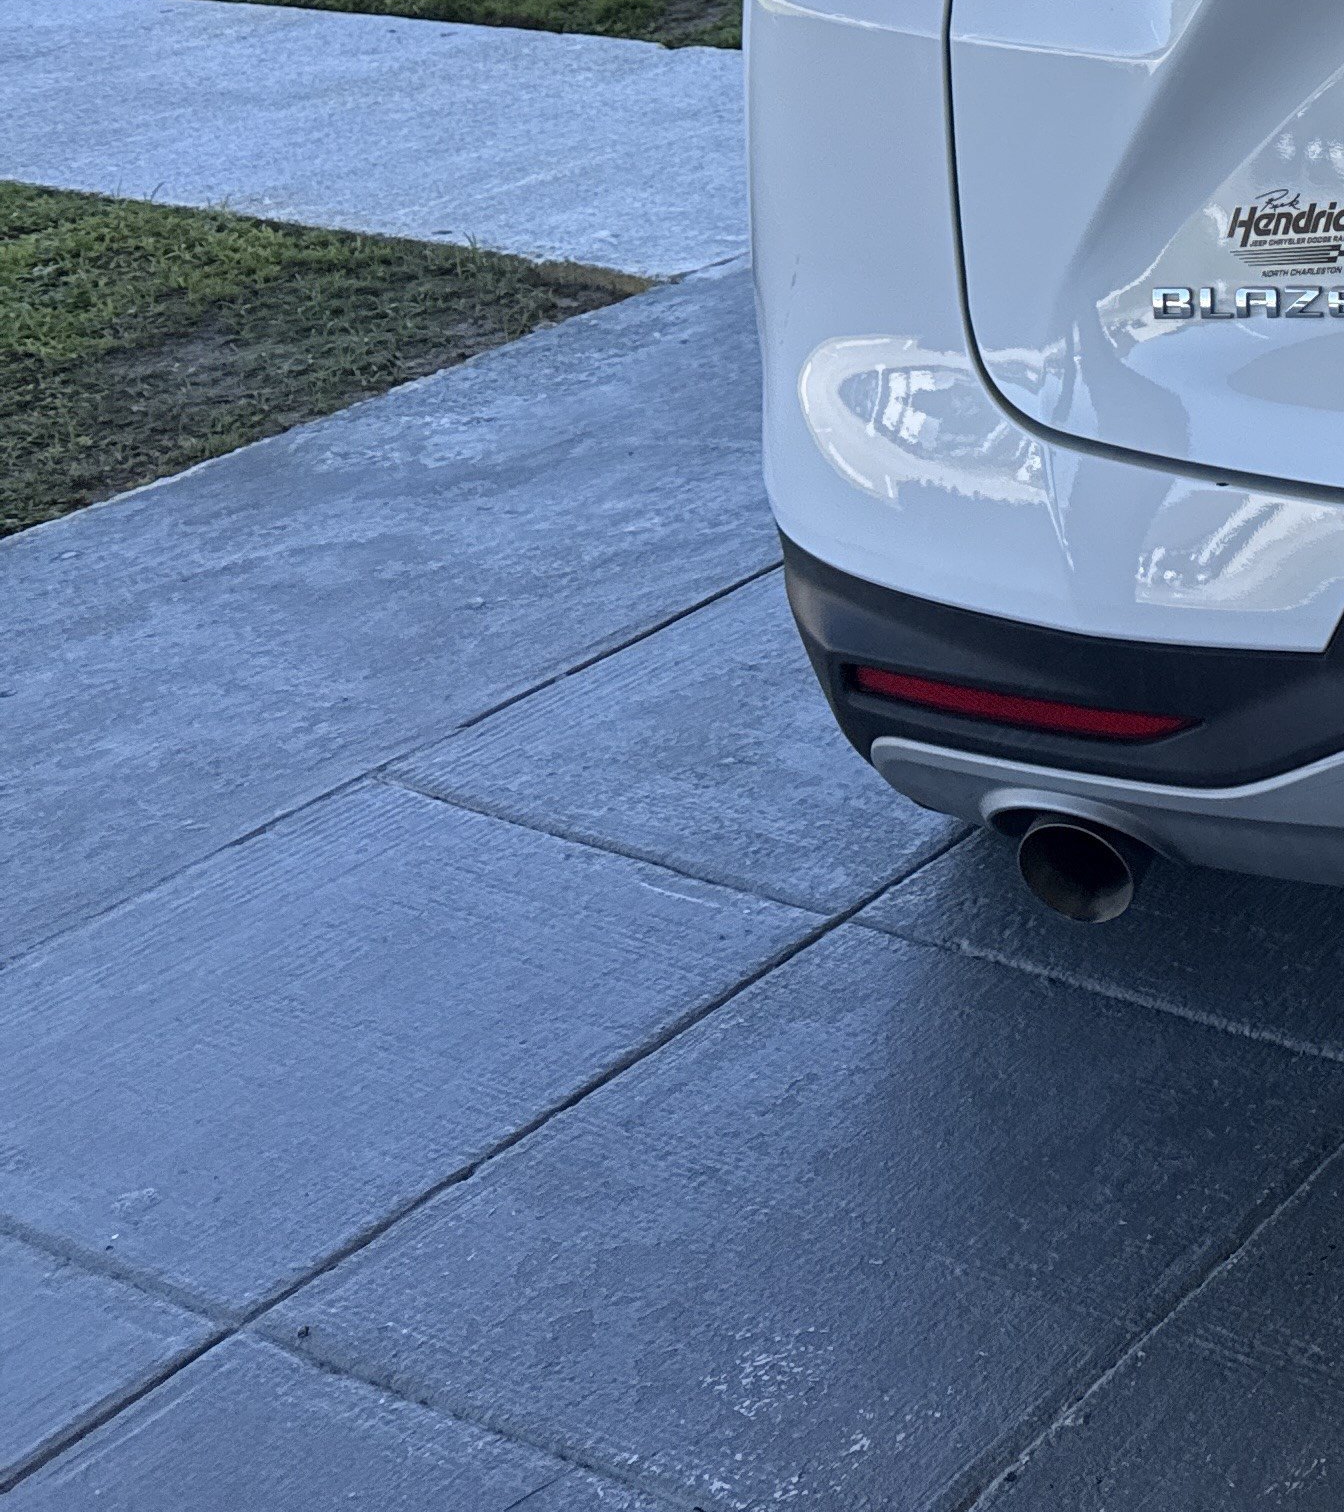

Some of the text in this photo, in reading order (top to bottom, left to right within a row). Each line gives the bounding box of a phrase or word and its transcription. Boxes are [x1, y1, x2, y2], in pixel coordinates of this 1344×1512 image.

[1249, 239, 1268, 247] JEEP
[1268, 236, 1306, 246] CHRYSLER
[1306, 235, 1332, 244] DODGE
[1261, 266, 1343, 278] NORTH CHARLESTON
